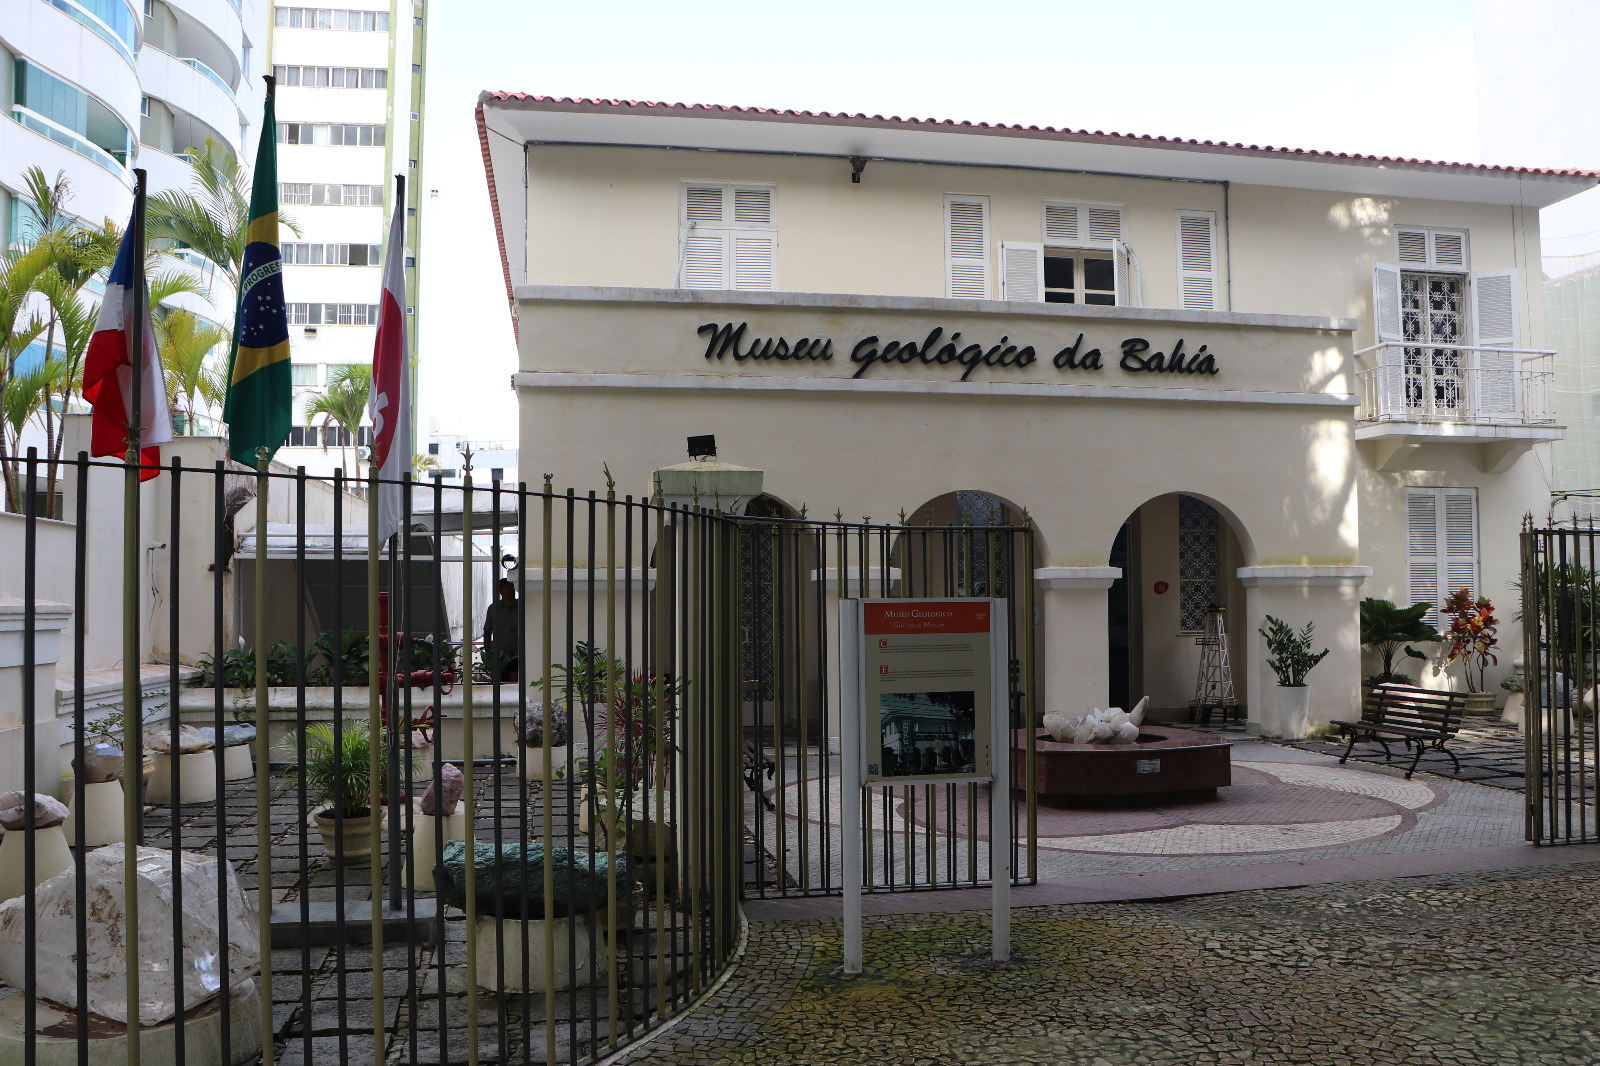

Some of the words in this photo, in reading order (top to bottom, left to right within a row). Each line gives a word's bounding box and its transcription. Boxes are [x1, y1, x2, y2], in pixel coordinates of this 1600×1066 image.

[697, 322, 833, 361] Museu
[1053, 333, 1103, 370] da
[1119, 338, 1219, 375] Bahia
